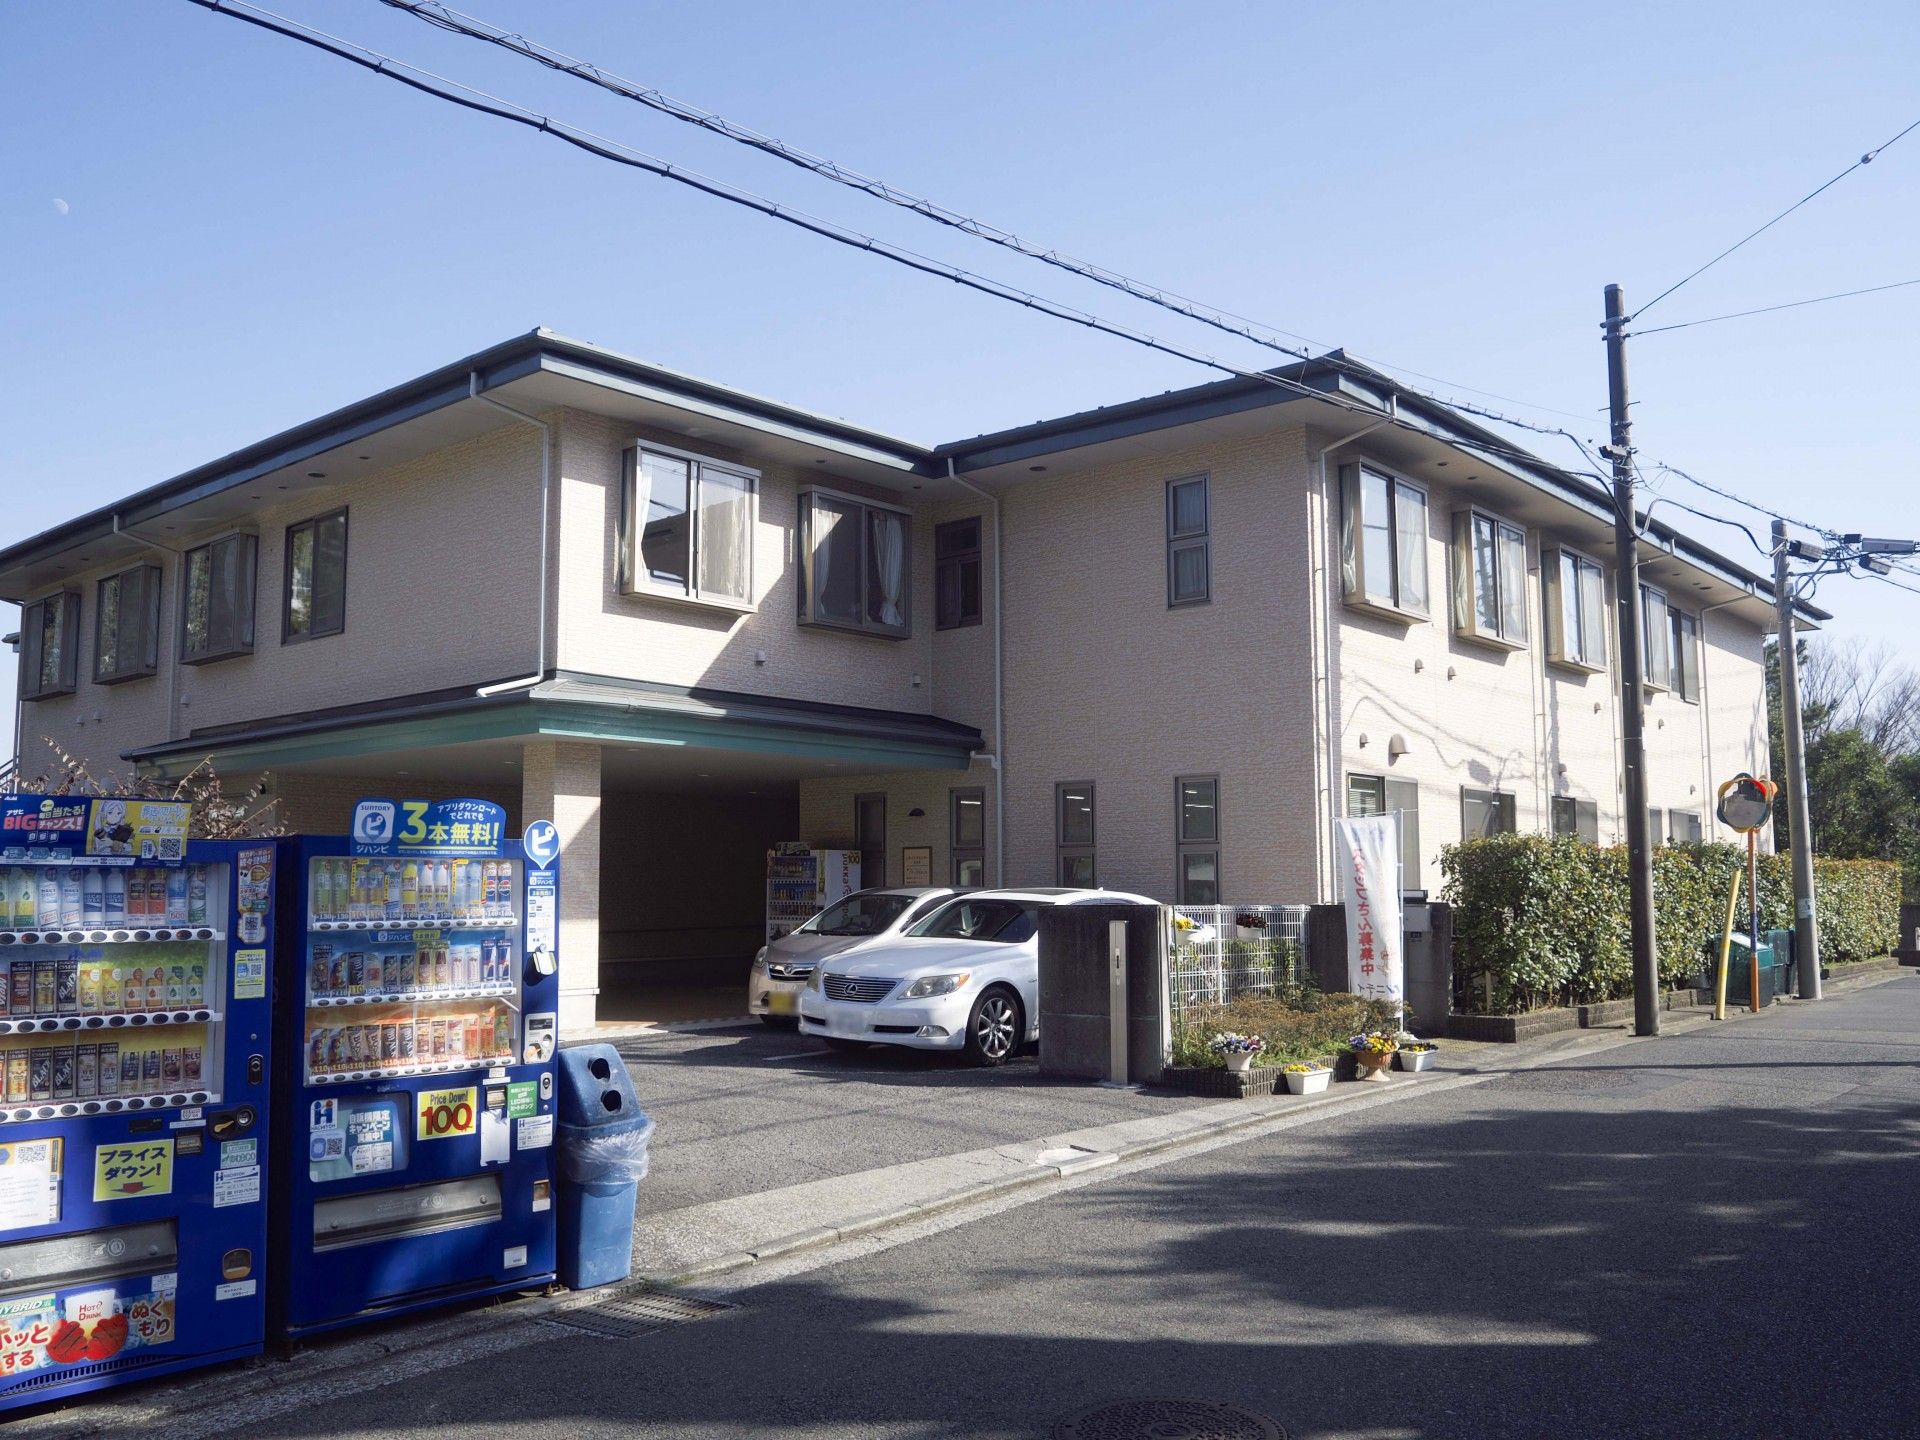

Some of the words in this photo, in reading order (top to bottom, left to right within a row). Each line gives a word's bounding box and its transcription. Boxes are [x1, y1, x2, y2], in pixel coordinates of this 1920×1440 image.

[4, 813, 39, 831] BIG
[6, 809, 24, 817] アサヒ
[430, 1095, 447, 1105] Price
[421, 1103, 473, 1136] 100
[104, 1163, 161, 1181] ダウン!
[132, 1300, 162, 1319] ぬく
[138, 1319, 170, 1337] もり
[3, 1350, 34, 1369] する
